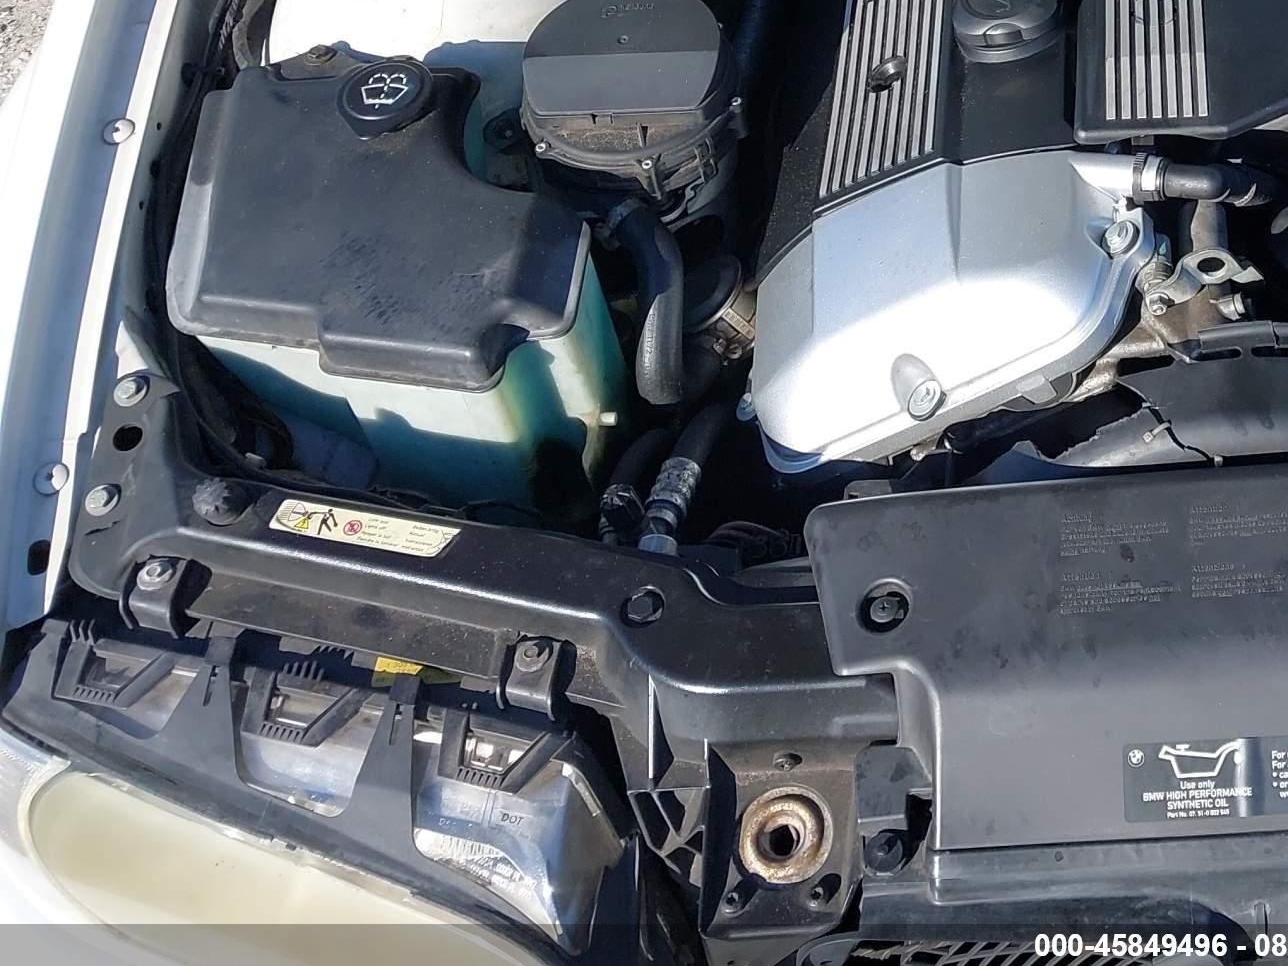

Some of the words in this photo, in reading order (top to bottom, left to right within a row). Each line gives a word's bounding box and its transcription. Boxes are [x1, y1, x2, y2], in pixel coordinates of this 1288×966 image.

[1271, 750, 1286, 760] For
[1271, 760, 1286, 770] For
[1180, 780, 1196, 790] Use
[1197, 779, 1216, 790] only
[1279, 780, 1288, 788] or
[1143, 791, 1165, 802] BMW
[1166, 790, 1187, 800] HIGH
[1188, 787, 1253, 799] PERFORMANCE
[1167, 800, 1214, 811] SYNTHETIC
[1214, 799, 1229, 808] OIL
[500, 812, 524, 826] DOT
